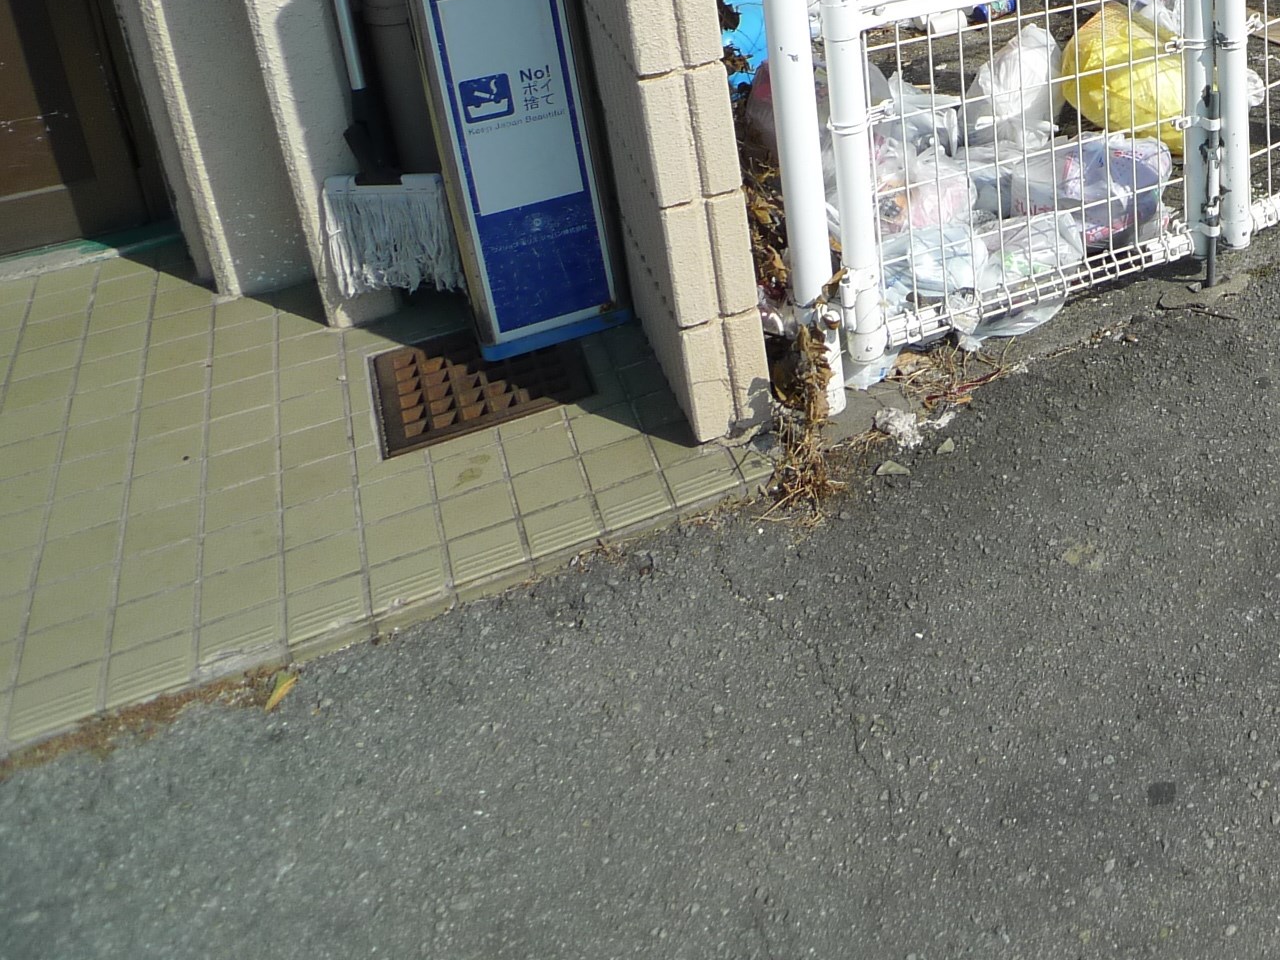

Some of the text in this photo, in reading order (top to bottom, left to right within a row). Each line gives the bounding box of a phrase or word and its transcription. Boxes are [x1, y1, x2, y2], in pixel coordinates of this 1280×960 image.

[519, 64, 551, 83] No!
[522, 78, 552, 96] ポイ
[523, 93, 555, 111] 捨て
